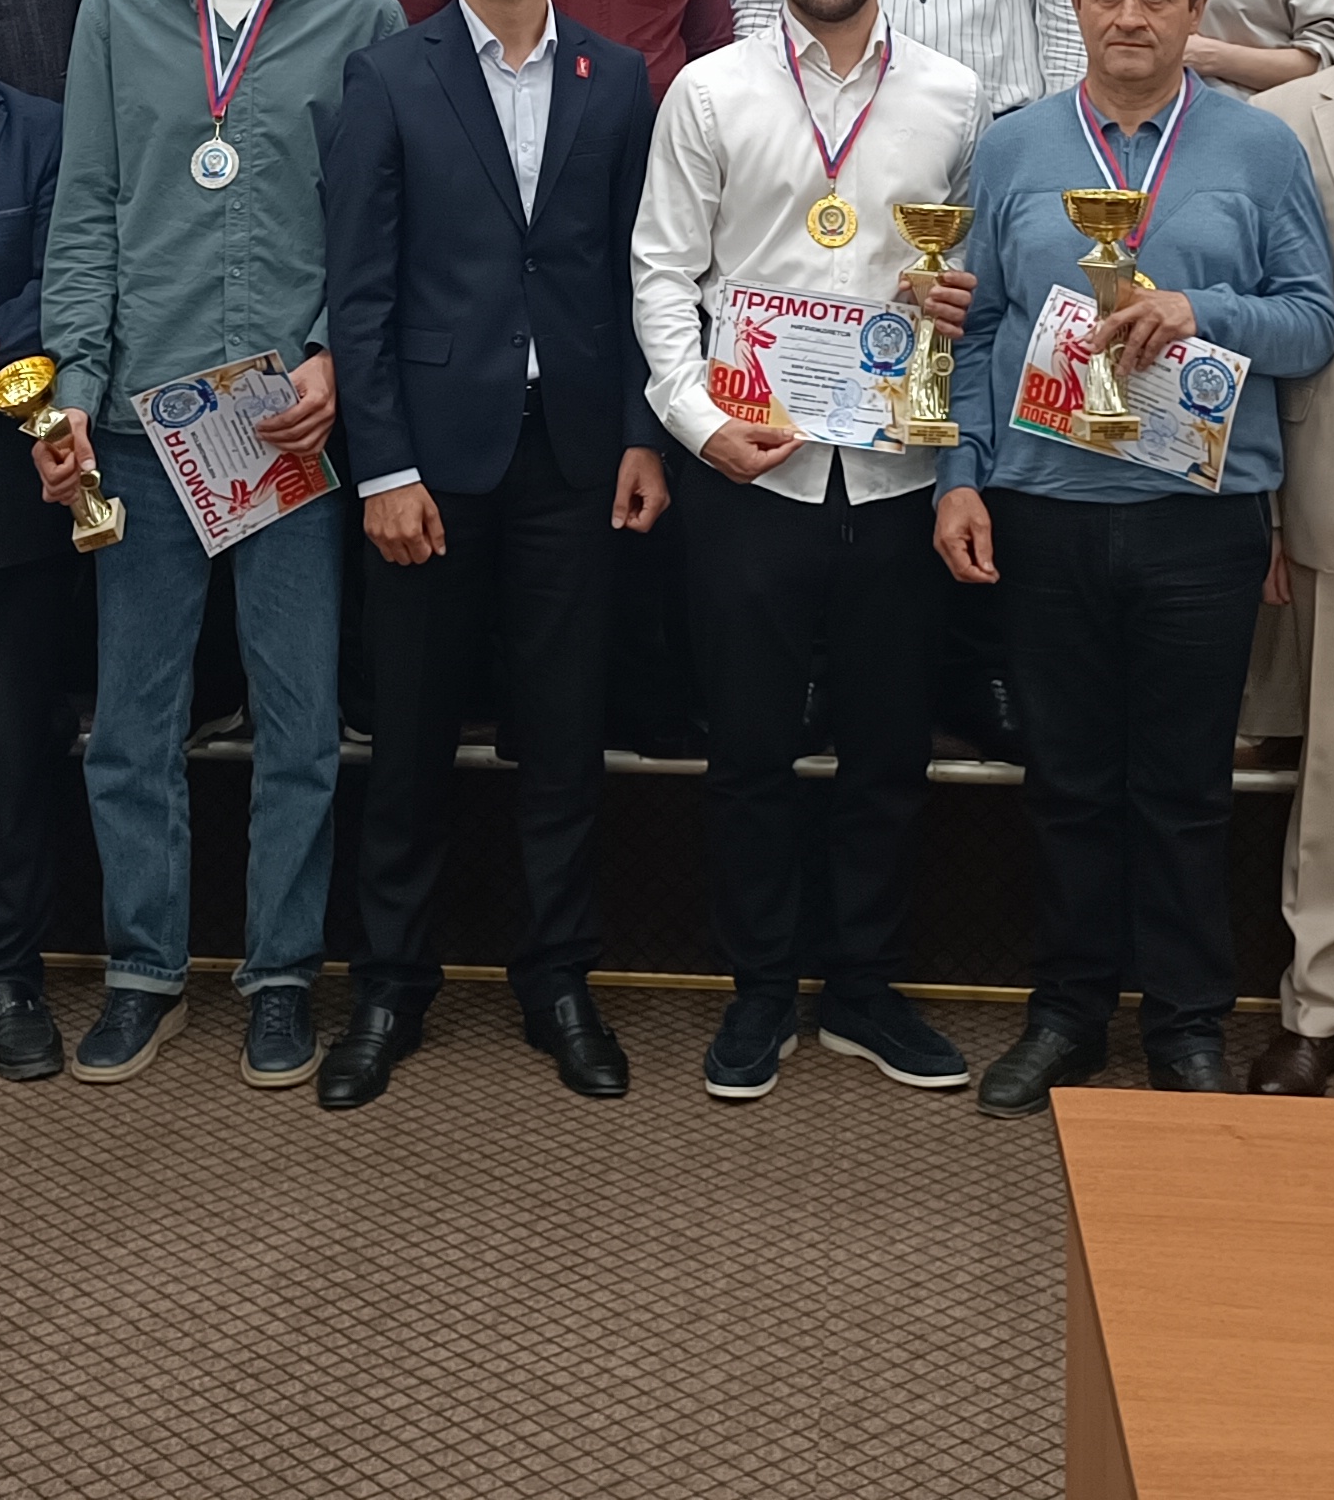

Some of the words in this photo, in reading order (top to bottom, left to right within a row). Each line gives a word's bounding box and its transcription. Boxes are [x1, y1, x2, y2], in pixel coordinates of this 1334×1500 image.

[731, 289, 865, 326] ГРАМОТА
[712, 366, 746, 399] 80
[1025, 372, 1062, 407] 80
[717, 401, 771, 425] ОБЕДА!
[1019, 405, 1073, 434] ПОБЕД
[163, 430, 229, 539] ГРАМОТА
[275, 472, 310, 505] 80
